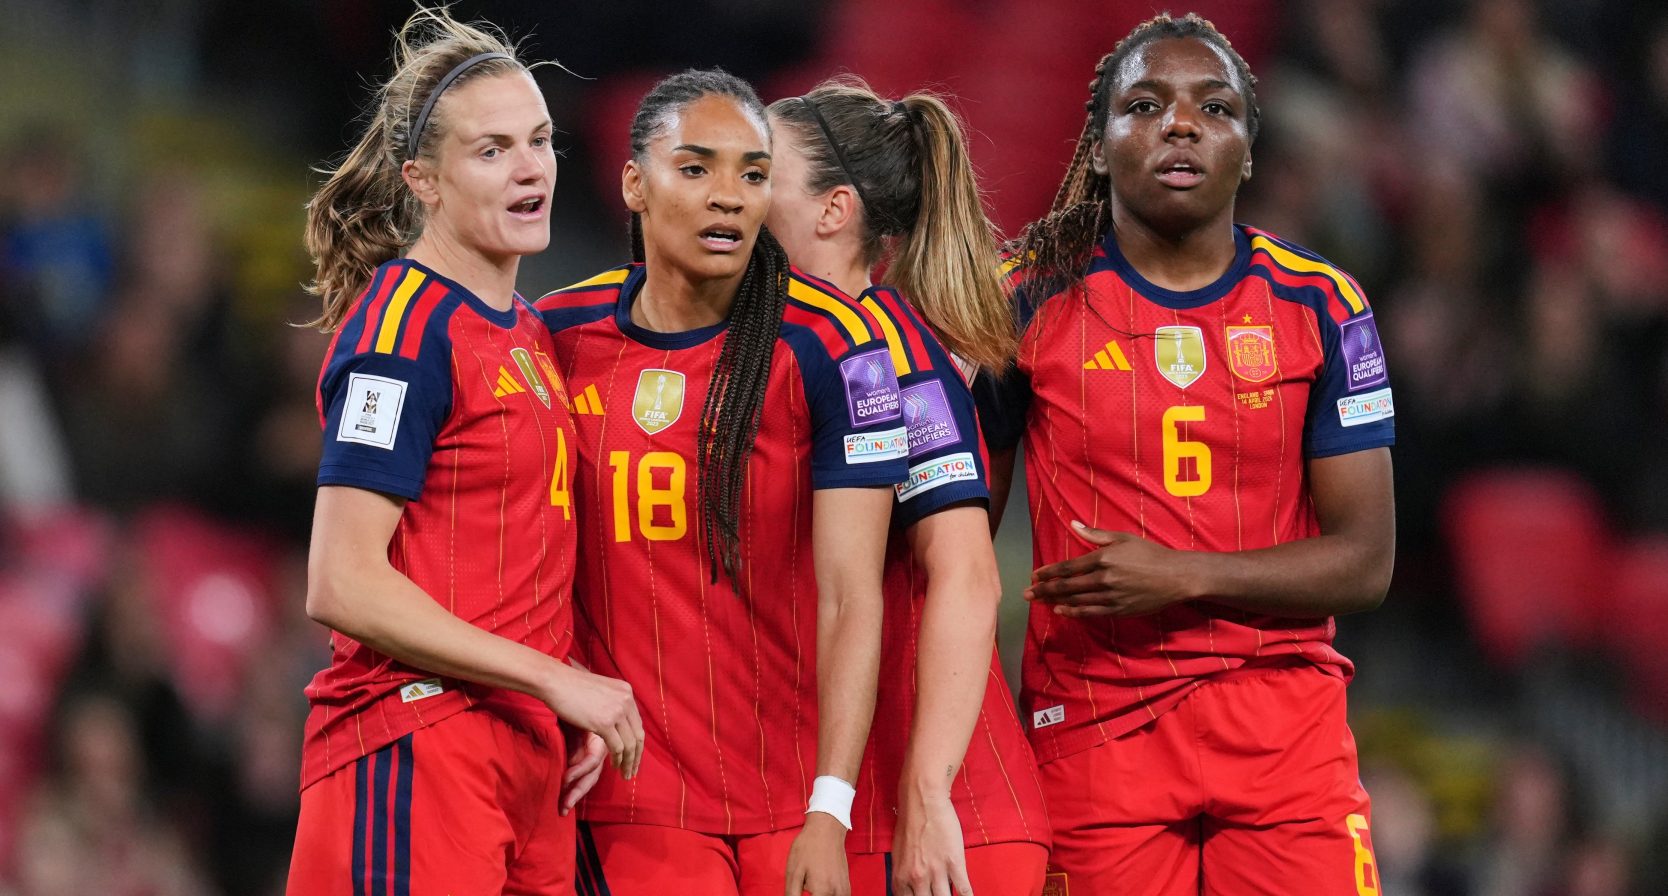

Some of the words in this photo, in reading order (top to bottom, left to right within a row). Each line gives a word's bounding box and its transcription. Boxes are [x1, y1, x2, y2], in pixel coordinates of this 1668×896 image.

[1353, 356, 1383, 373] EUROPEAN
[857, 393, 898, 409] EUROPEAN
[857, 401, 899, 417] QUALIFIERS
[1340, 398, 1392, 417] FOUNDATION
[644, 410, 666, 419] FIFA
[847, 435, 866, 444] UEFA
[908, 421, 948, 440] ROPEAN
[847, 436, 907, 454] FOUNDATION
[1162, 406, 1212, 497] 6
[550, 427, 571, 520] 4
[896, 460, 974, 493] FOUNDATION
[609, 451, 687, 542] 18
[1346, 813, 1379, 896] 6
